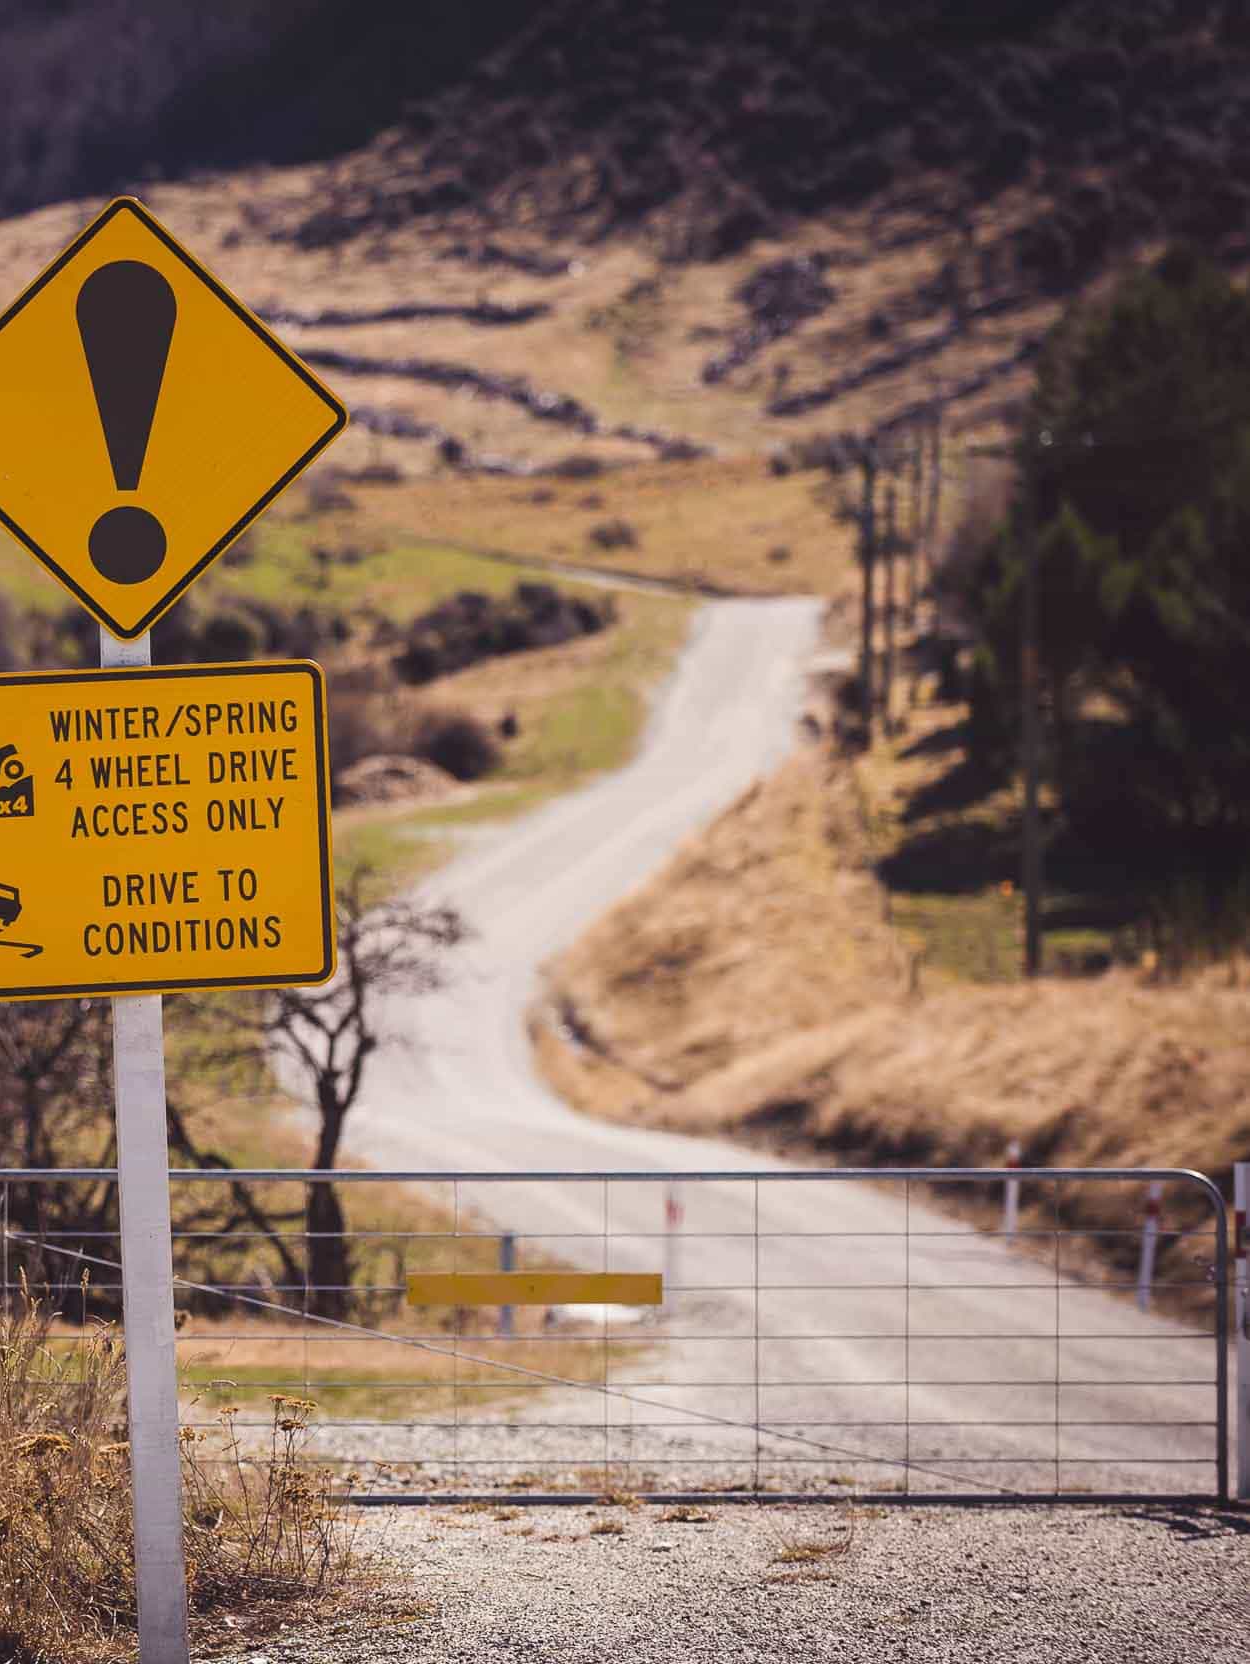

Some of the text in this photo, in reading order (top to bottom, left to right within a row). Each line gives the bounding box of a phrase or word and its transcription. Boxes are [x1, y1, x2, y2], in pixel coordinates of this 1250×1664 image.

[50, 700, 298, 742] WINTER/SPRING
[54, 749, 298, 790] 4 WHEEL DRIVE
[71, 797, 285, 838] ACCESS ONLY
[103, 869, 257, 907] DRIVE TO
[84, 916, 282, 956] CONDITIONS
